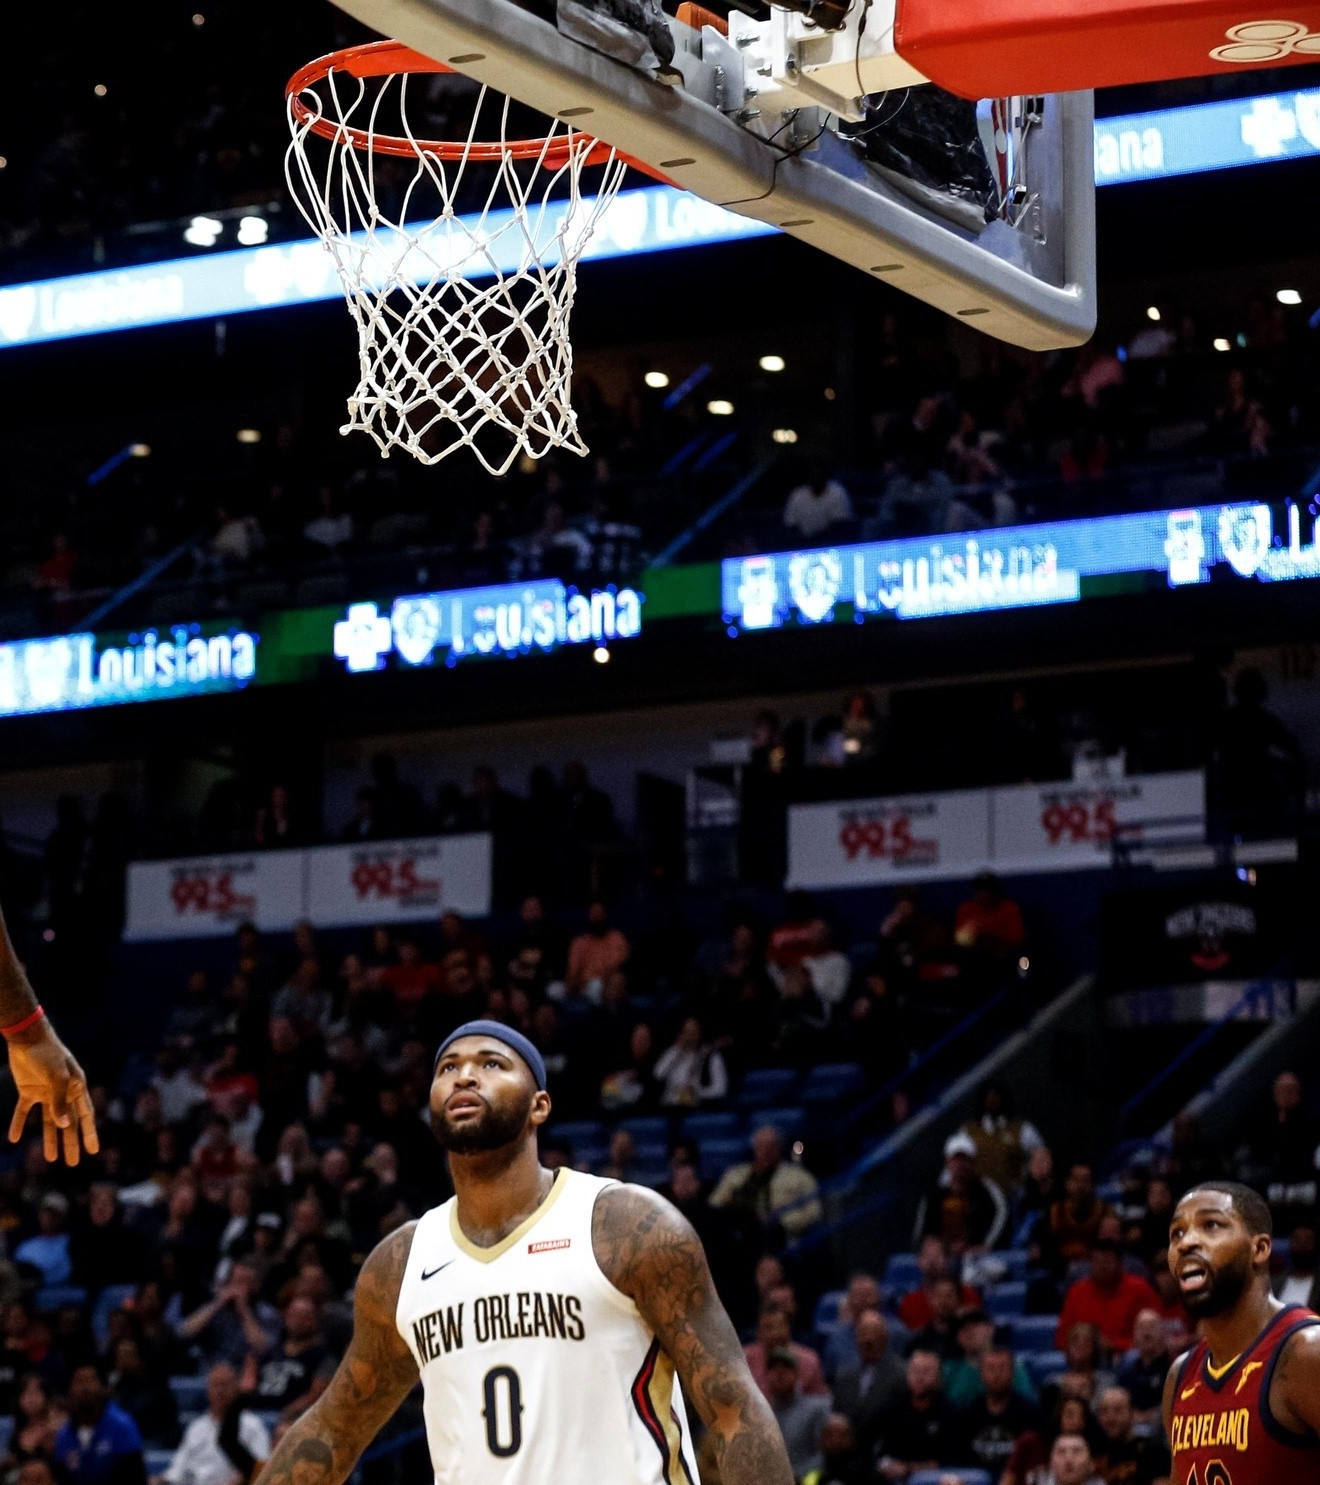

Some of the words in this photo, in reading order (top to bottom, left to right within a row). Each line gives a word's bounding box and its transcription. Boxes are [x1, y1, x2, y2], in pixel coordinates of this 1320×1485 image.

[853, 540, 1058, 610] Louisiana
[450, 588, 642, 653] Louisiana
[78, 630, 256, 696] Louisiana
[412, 1302, 464, 1368] NEW
[473, 1292, 585, 1343] ORLEANS
[481, 1364, 524, 1458] 0
[1171, 1407, 1250, 1457] CLEVELAND
